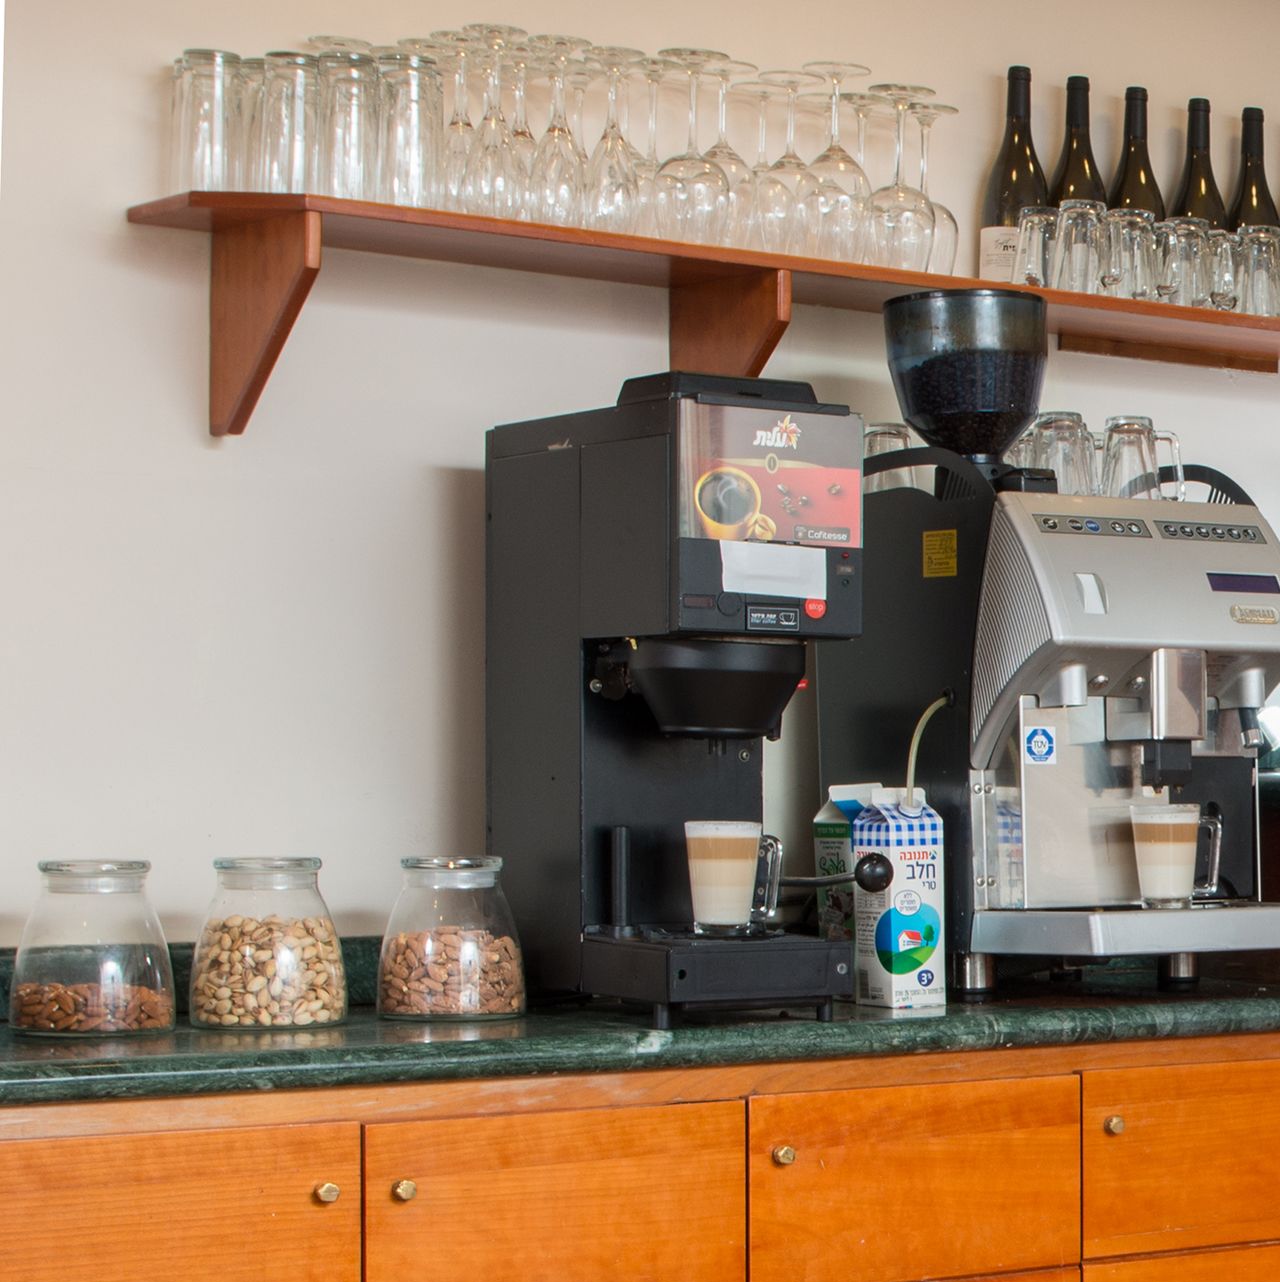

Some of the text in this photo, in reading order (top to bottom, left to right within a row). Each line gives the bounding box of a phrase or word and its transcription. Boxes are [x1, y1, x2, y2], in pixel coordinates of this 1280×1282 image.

[807, 529, 848, 541] Cafitesse
[900, 851, 929, 861] תנובה
[906, 861, 936, 880] חלב
[922, 881, 936, 890] טרי
[920, 973, 933, 985] 3%
